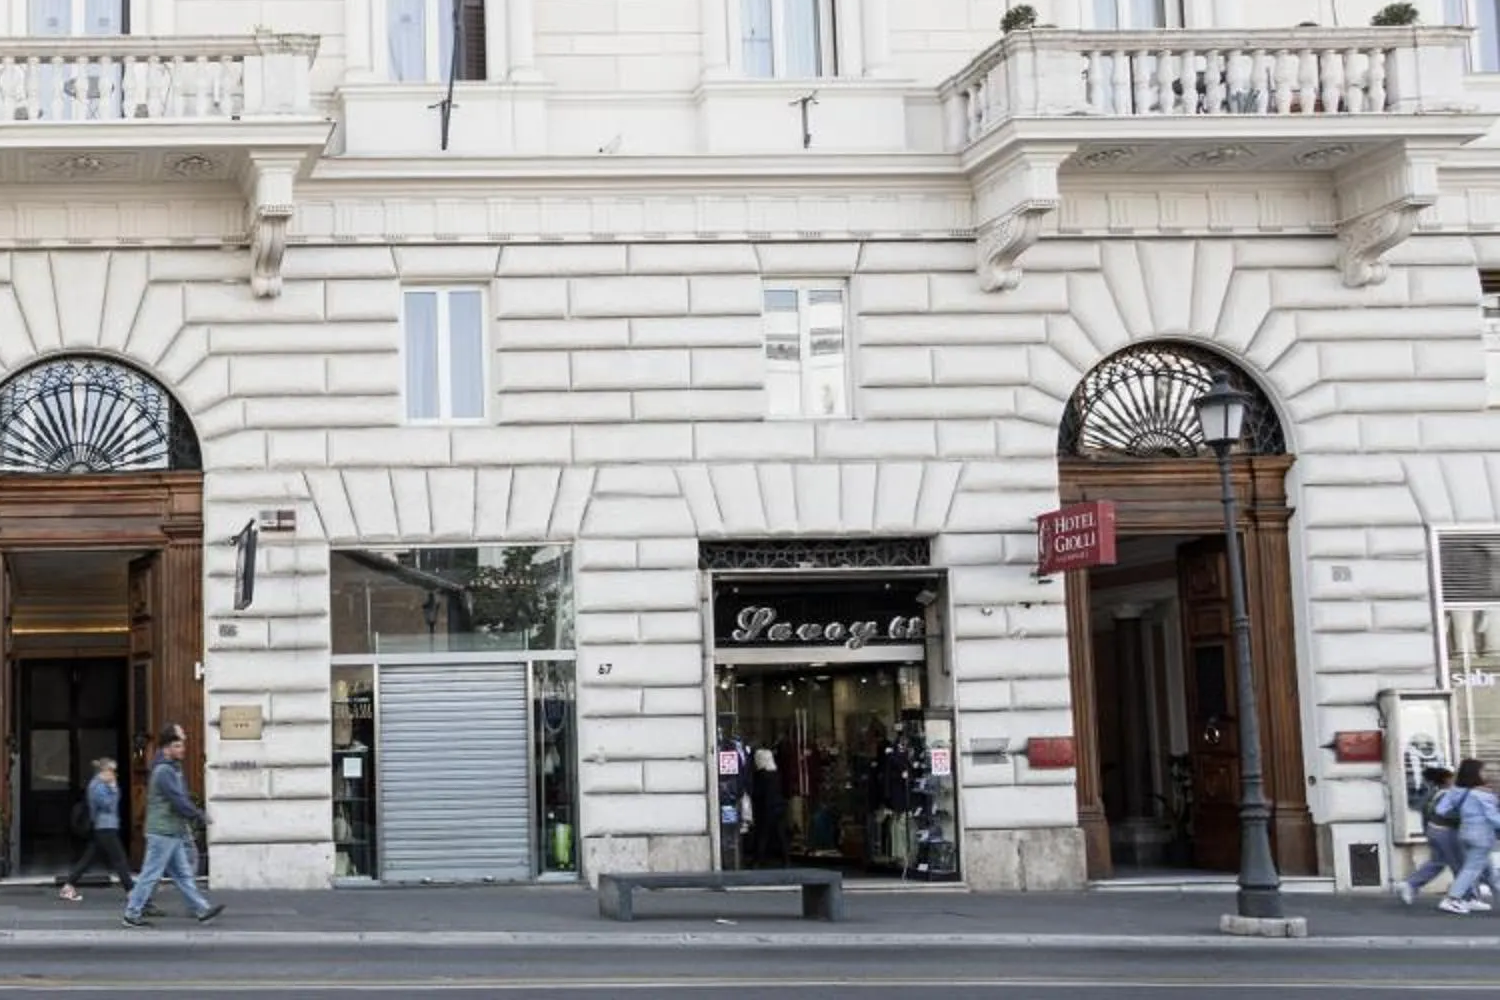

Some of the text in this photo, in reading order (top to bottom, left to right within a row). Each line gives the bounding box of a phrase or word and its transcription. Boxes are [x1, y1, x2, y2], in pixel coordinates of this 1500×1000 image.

[1054, 512, 1097, 534] HOTEL
[1054, 531, 1096, 553] GIOLLI
[731, 606, 878, 650] Savoy
